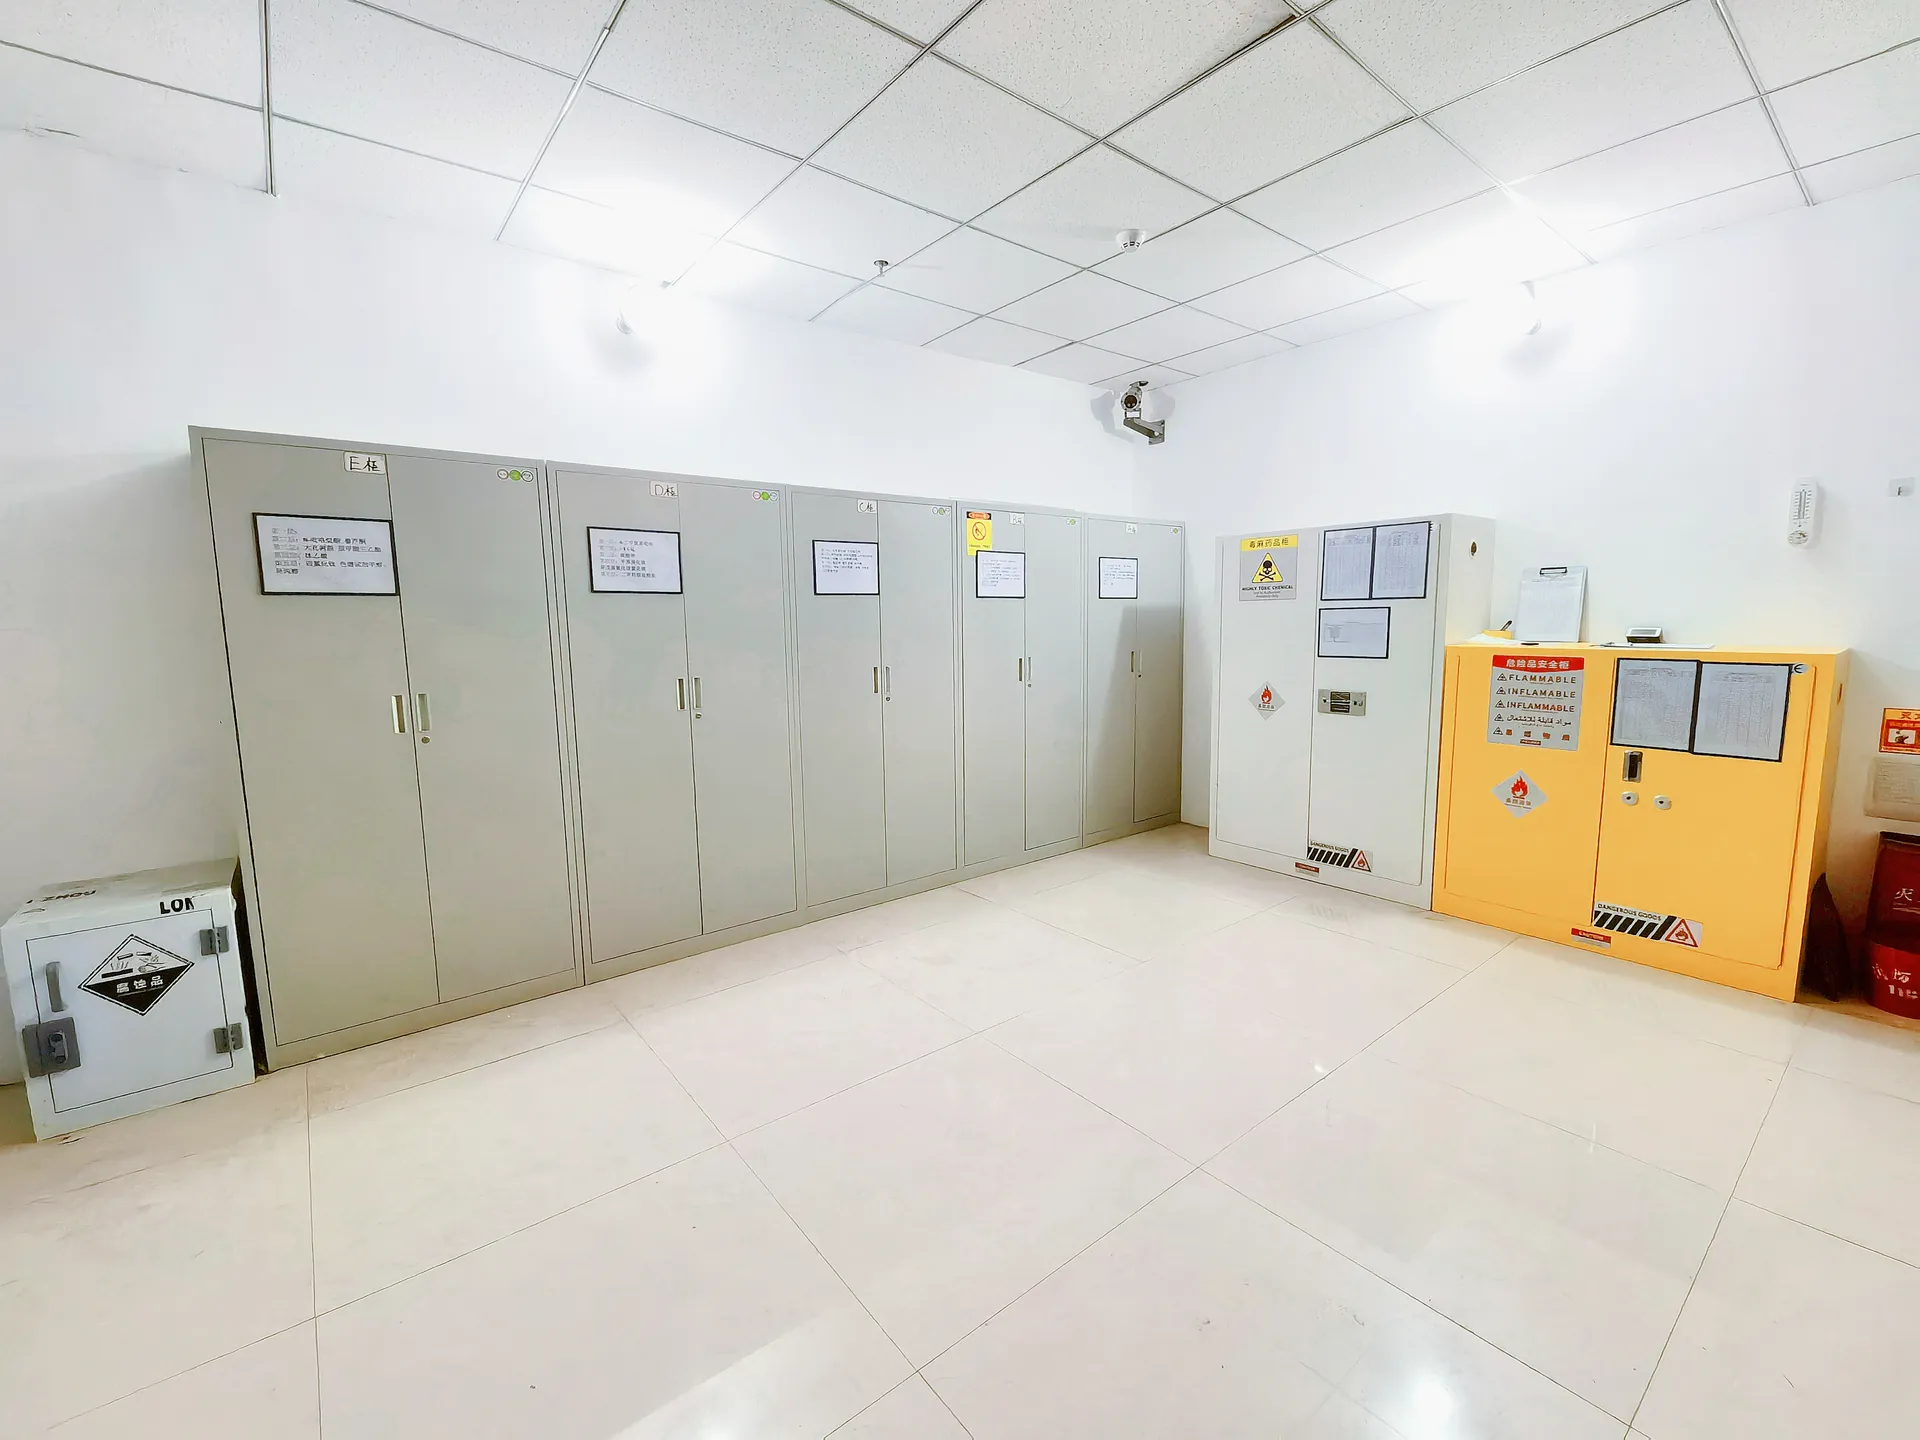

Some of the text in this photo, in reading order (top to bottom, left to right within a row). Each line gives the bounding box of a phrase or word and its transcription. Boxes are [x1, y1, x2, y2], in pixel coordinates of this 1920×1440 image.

[1506, 659, 1570, 669] 危险品安全柜
[1508, 674, 1577, 684] FLAMMABLE
[1507, 688, 1576, 698] INFLAMABLE
[1506, 701, 1575, 712] INFLAMMABLE
[1597, 903, 1662, 921] DANGEROUS GOODS
